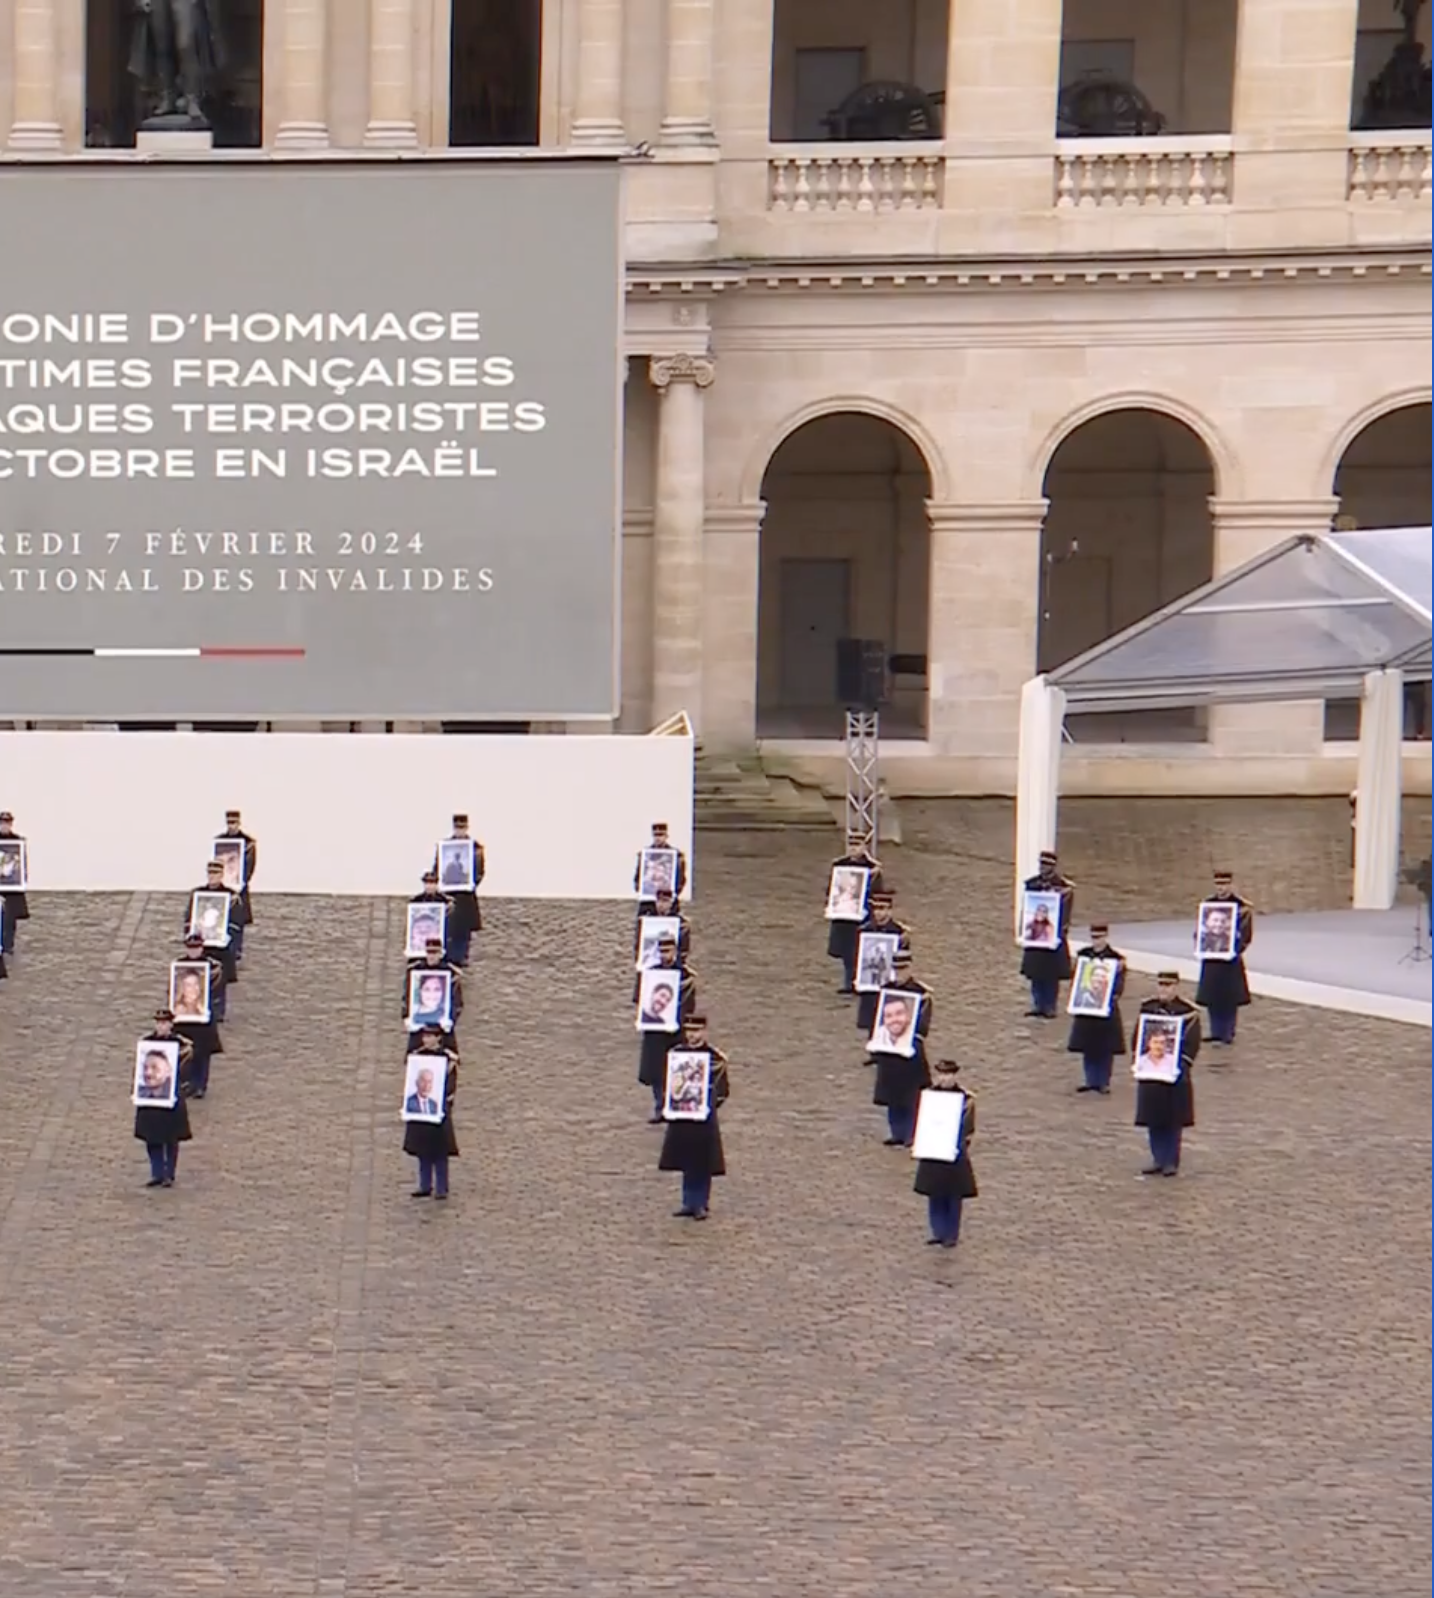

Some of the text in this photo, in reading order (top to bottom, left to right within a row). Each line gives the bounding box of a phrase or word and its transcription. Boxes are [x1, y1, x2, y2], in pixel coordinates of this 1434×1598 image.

[149, 312, 481, 342] D’HOMMAGE
[173, 357, 515, 395] FRANÇAISES
[170, 402, 547, 432] TERRORISTES
[215, 449, 286, 477] EN
[307, 440, 498, 477] ISRAËL
[106, 533, 121, 554] 7
[145, 528, 315, 555] FÉVRIER
[337, 532, 424, 554] 2024
[182, 568, 255, 591] DES
[277, 568, 494, 591] INVALIDES
